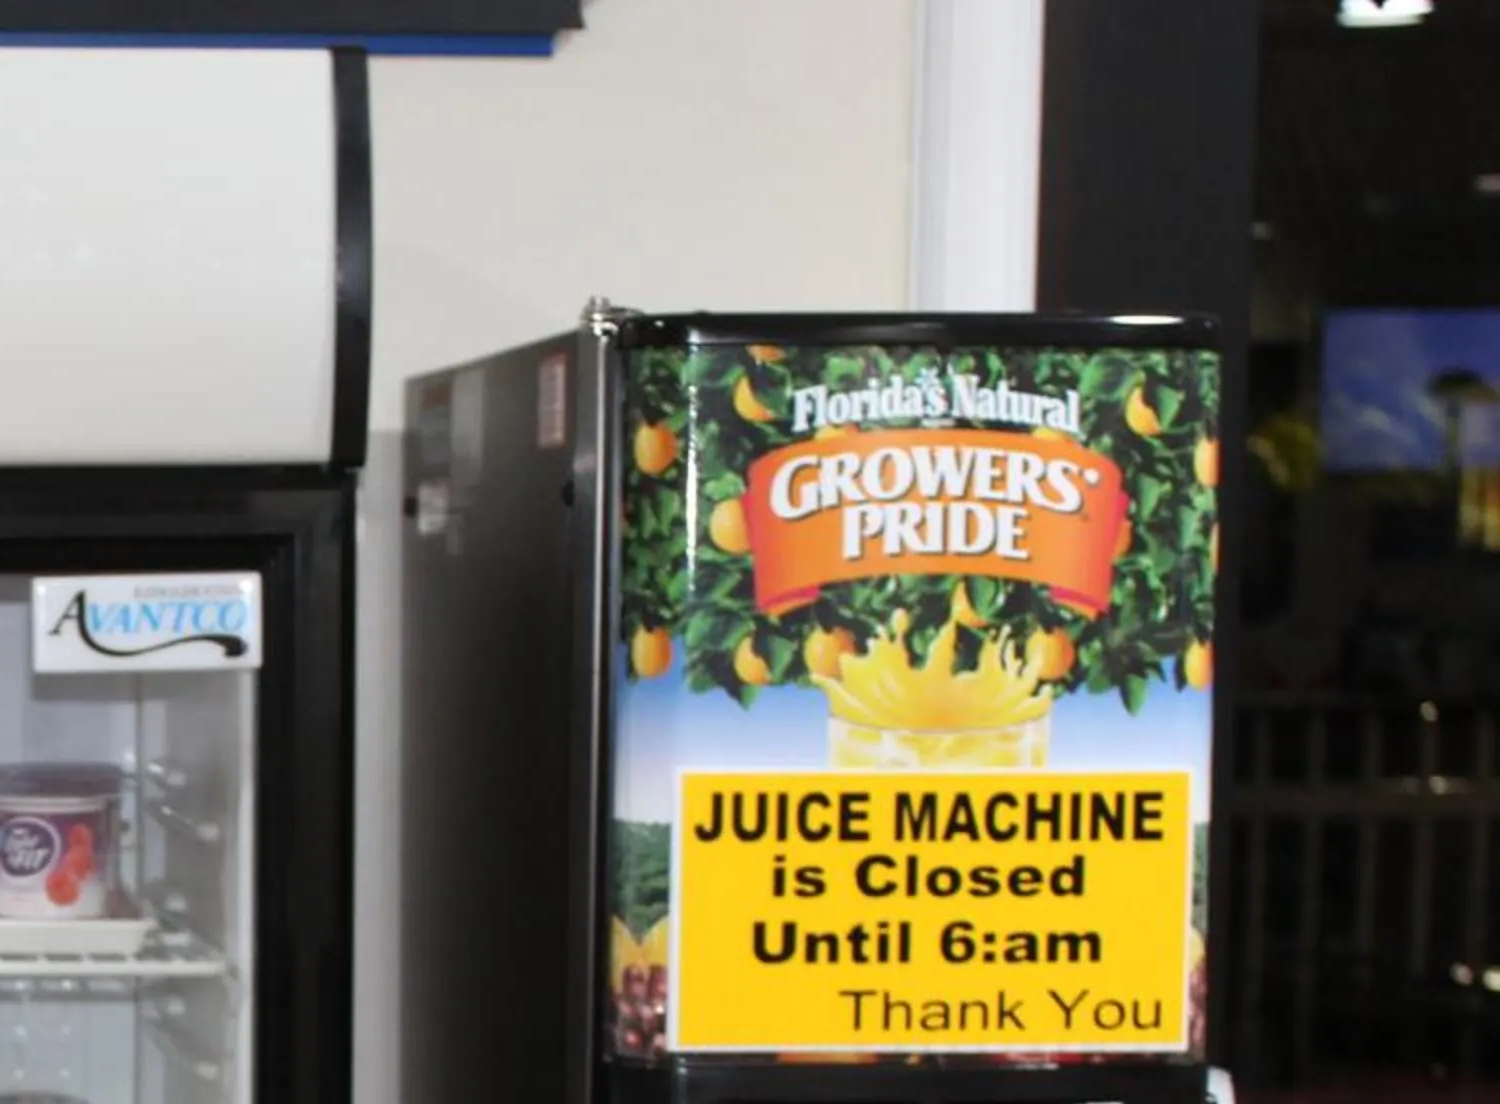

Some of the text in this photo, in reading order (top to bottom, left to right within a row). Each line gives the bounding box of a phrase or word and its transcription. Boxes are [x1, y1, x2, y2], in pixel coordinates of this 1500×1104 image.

[792, 368, 1080, 434] Florida's Natural
[843, 503, 1030, 560] PRIDE
[48, 590, 248, 658] AVANTCO
[694, 791, 1164, 842] JUICE MACHINE
[772, 854, 1086, 898] is Closed
[752, 920, 1103, 964] Until 6:am
[839, 989, 1162, 1031] Thank You
